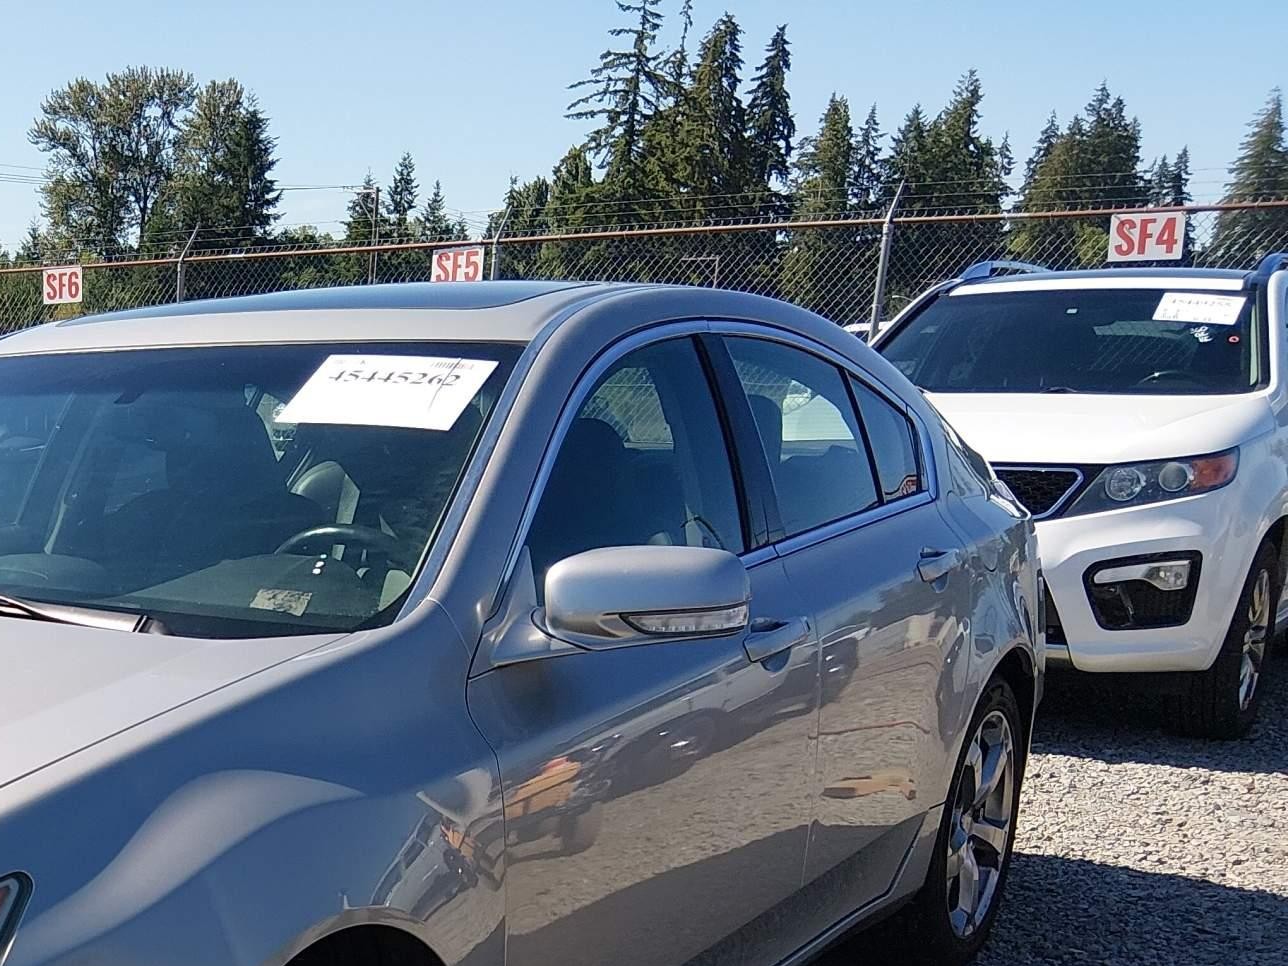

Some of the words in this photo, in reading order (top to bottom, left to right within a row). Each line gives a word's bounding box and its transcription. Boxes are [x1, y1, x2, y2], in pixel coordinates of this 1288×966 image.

[1114, 217, 1178, 256] SF4
[435, 250, 479, 282] SF5
[46, 271, 79, 300] SF6
[328, 370, 461, 386] 45445262
